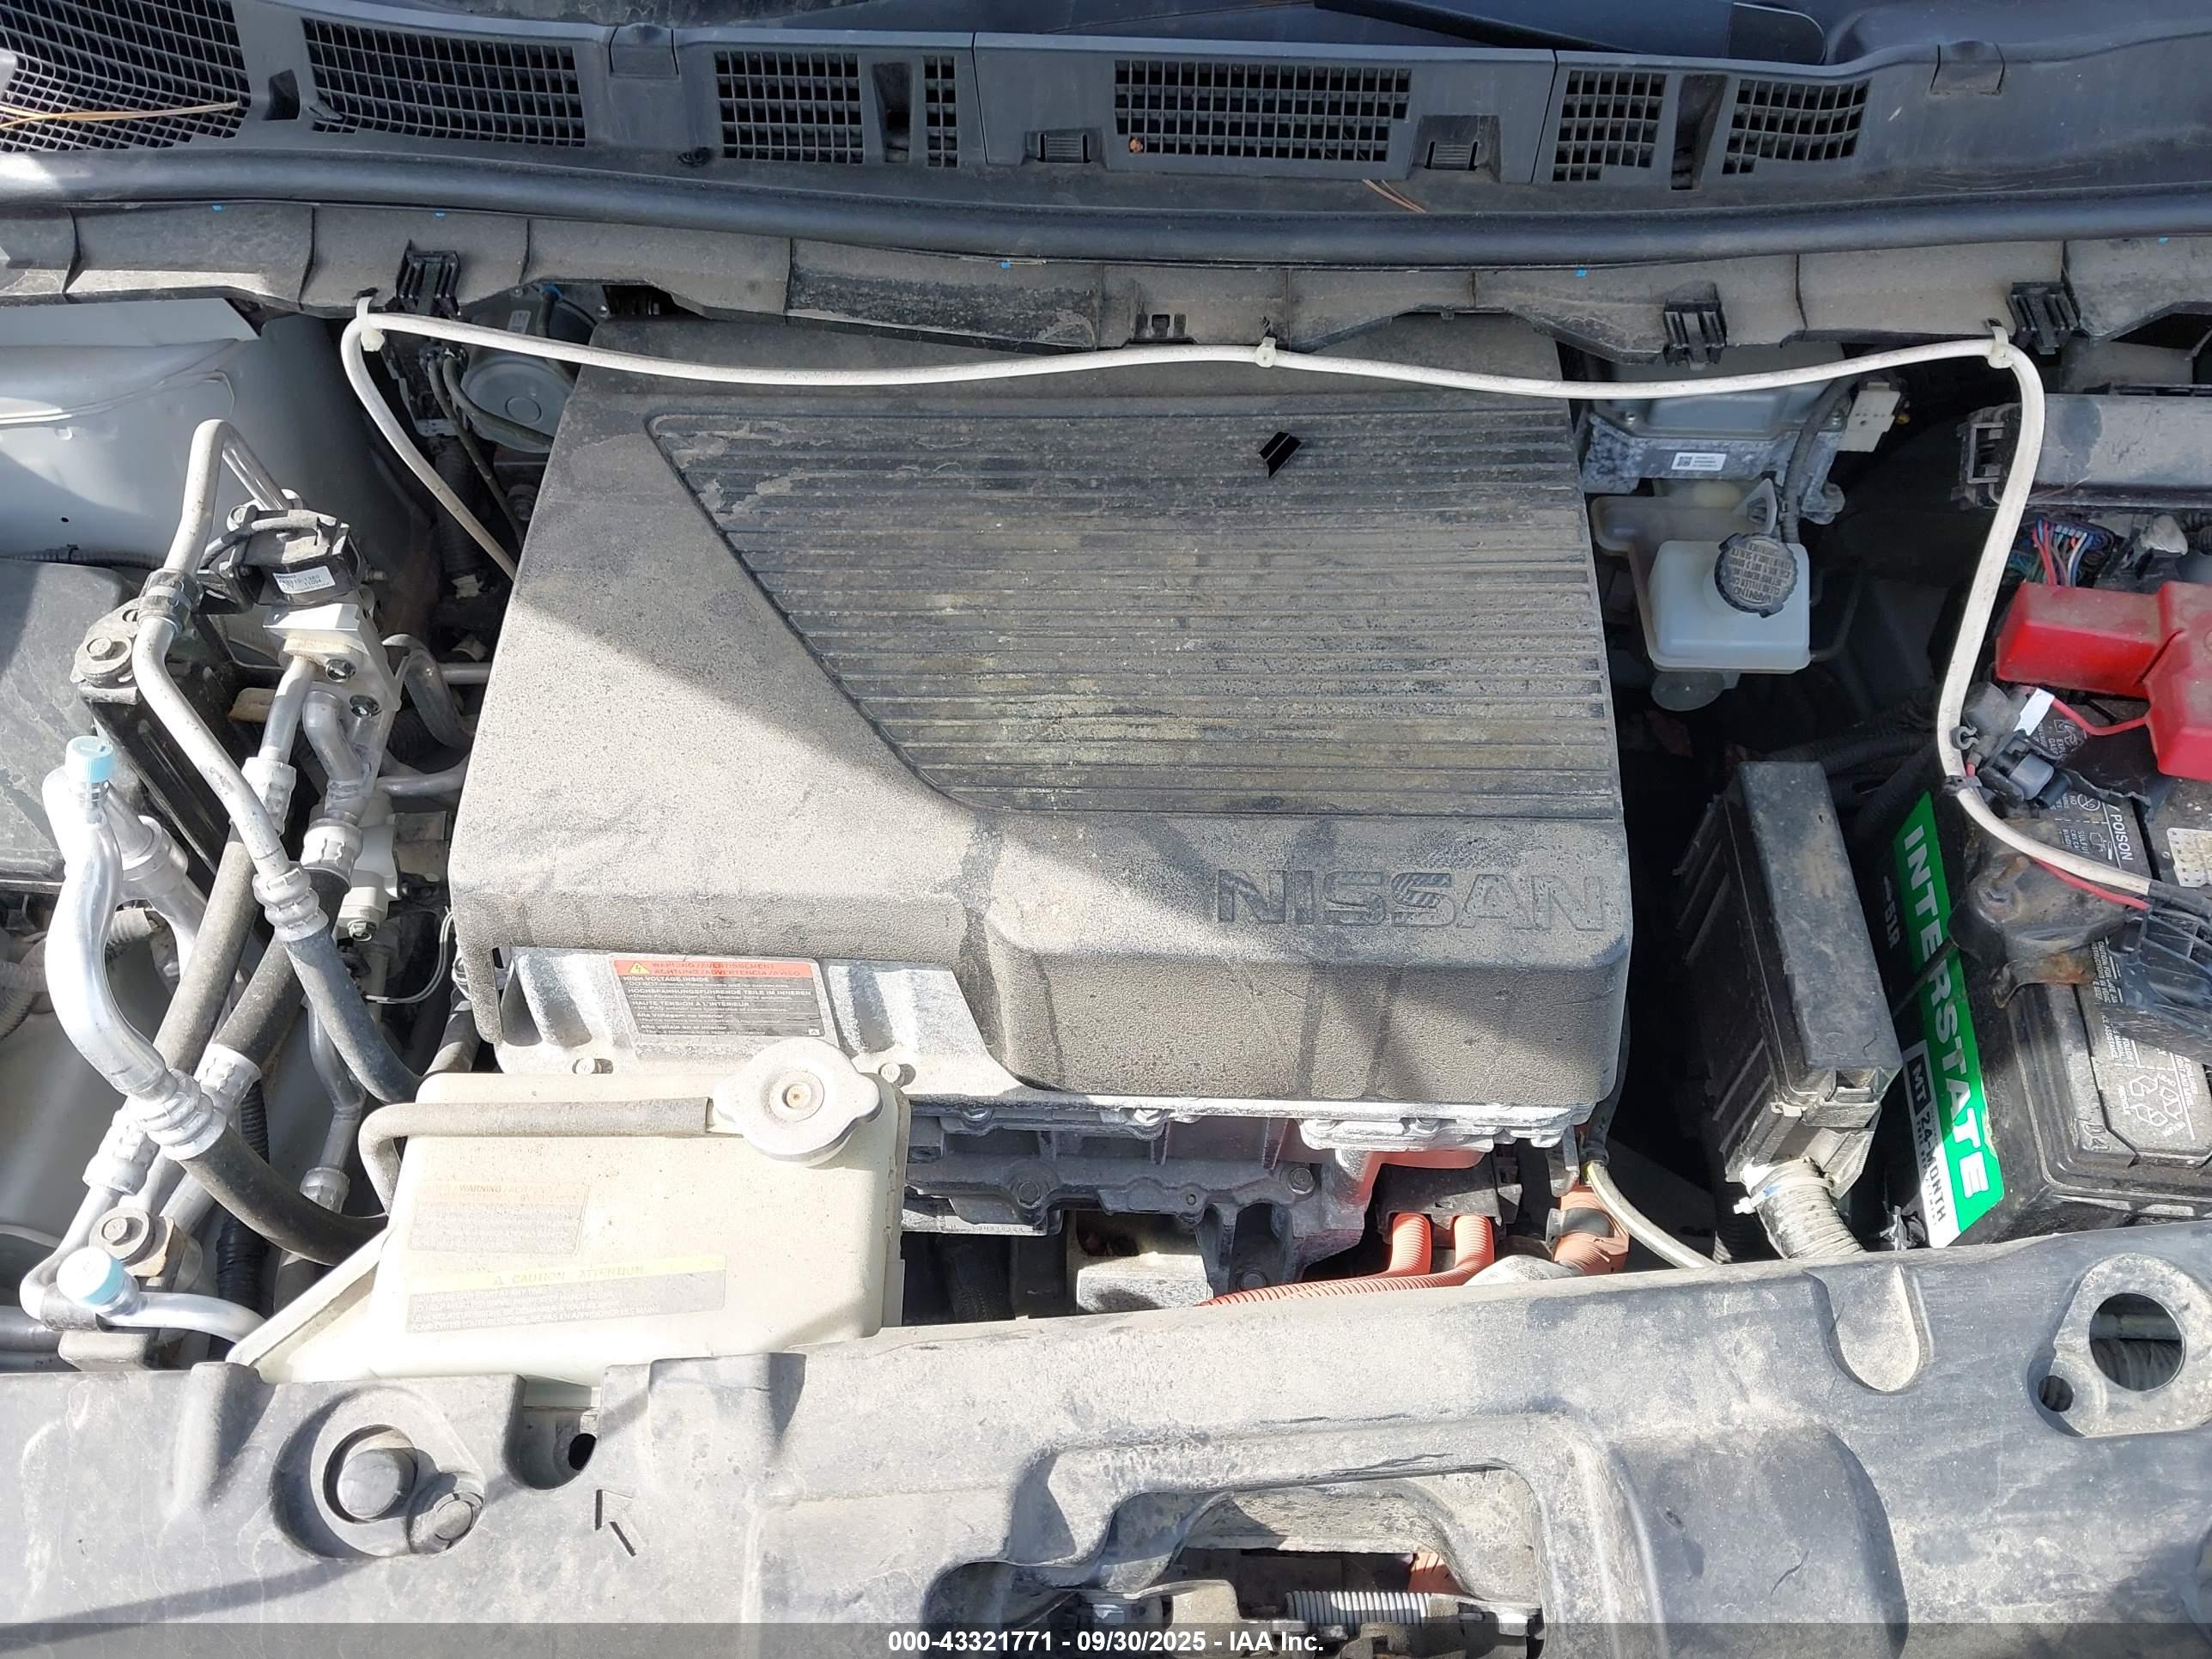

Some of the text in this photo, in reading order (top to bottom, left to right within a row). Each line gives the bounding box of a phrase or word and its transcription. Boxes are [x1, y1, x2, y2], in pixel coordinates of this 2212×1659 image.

[2110, 814, 2134, 860] POISON
[1217, 869, 1606, 932] NISSAN
[1904, 824, 1990, 1199] INTERSTATE
[1911, 1062, 1928, 1103] MT
[1920, 1111, 1947, 1223] 24-MONTH
